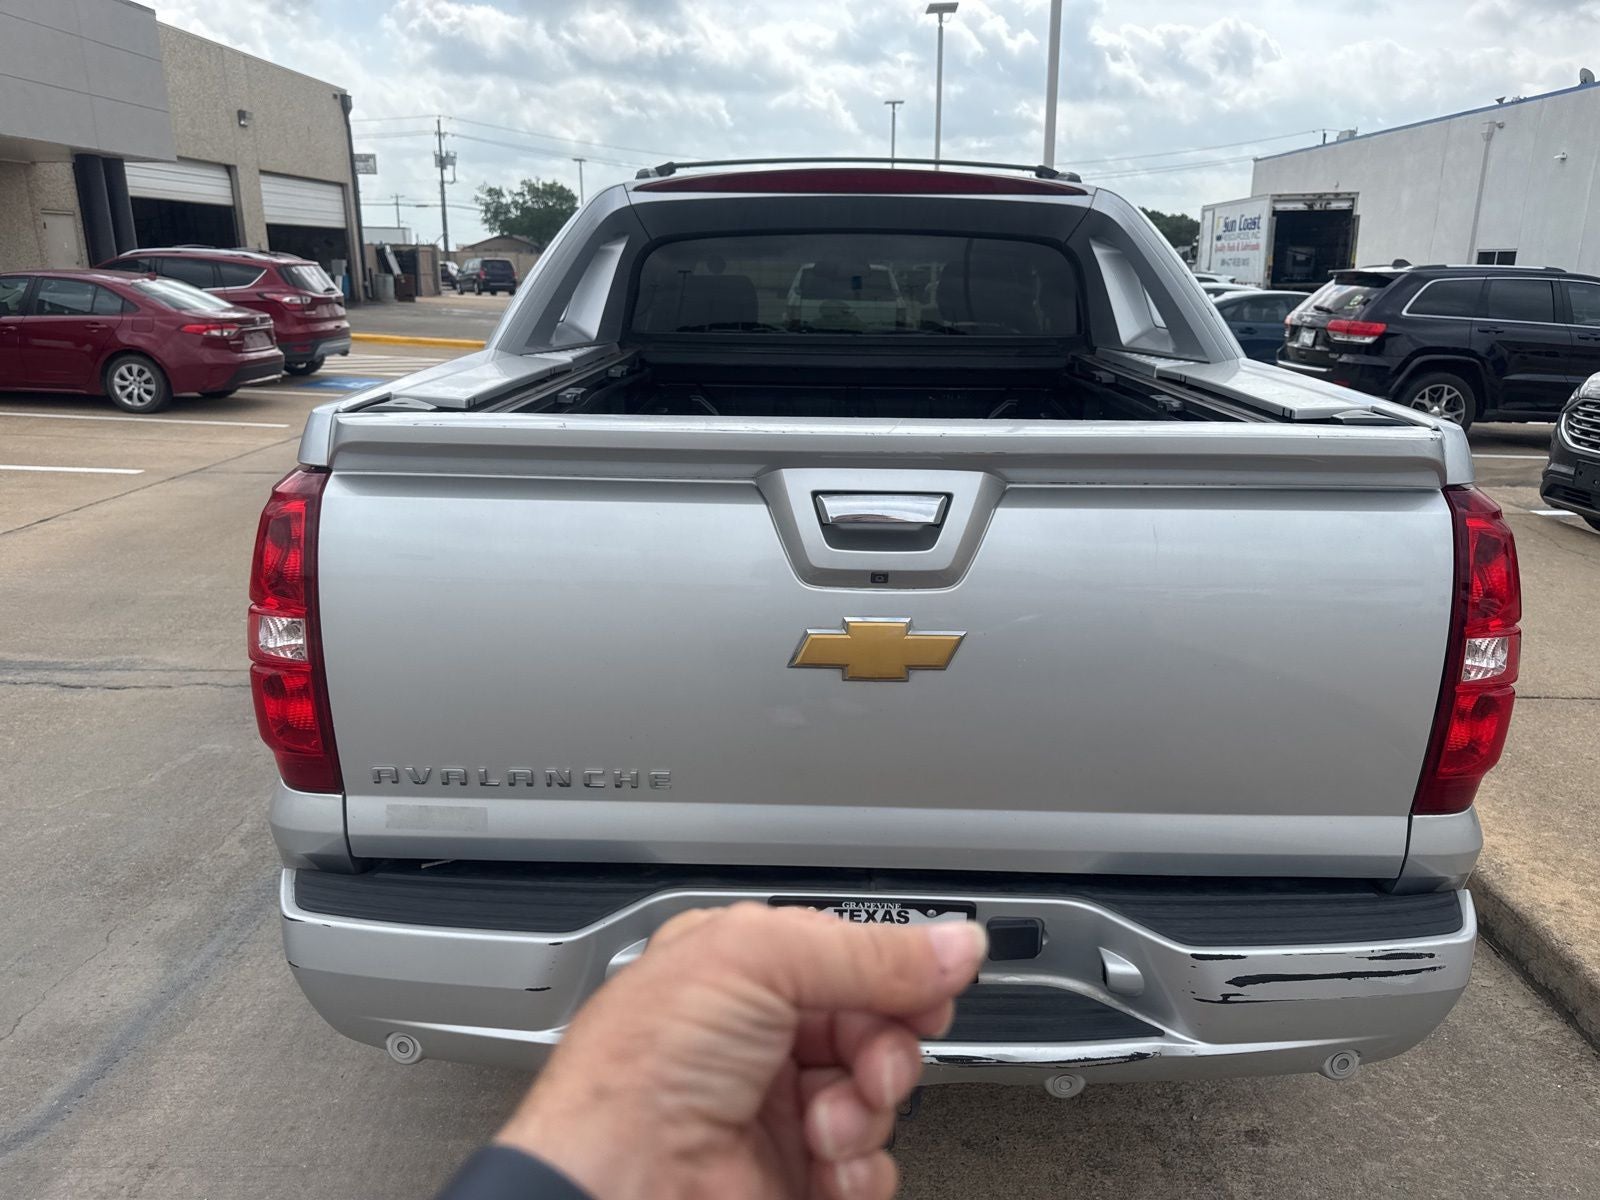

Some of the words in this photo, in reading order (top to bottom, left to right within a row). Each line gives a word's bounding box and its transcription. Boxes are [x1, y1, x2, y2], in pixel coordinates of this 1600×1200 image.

[1222, 217, 1236, 232] Sun
[1239, 214, 1261, 230] Coast
[371, 765, 672, 789] AVALANCHE
[841, 901, 902, 910] GRAPEVINE
[833, 908, 911, 924] TEXAS
